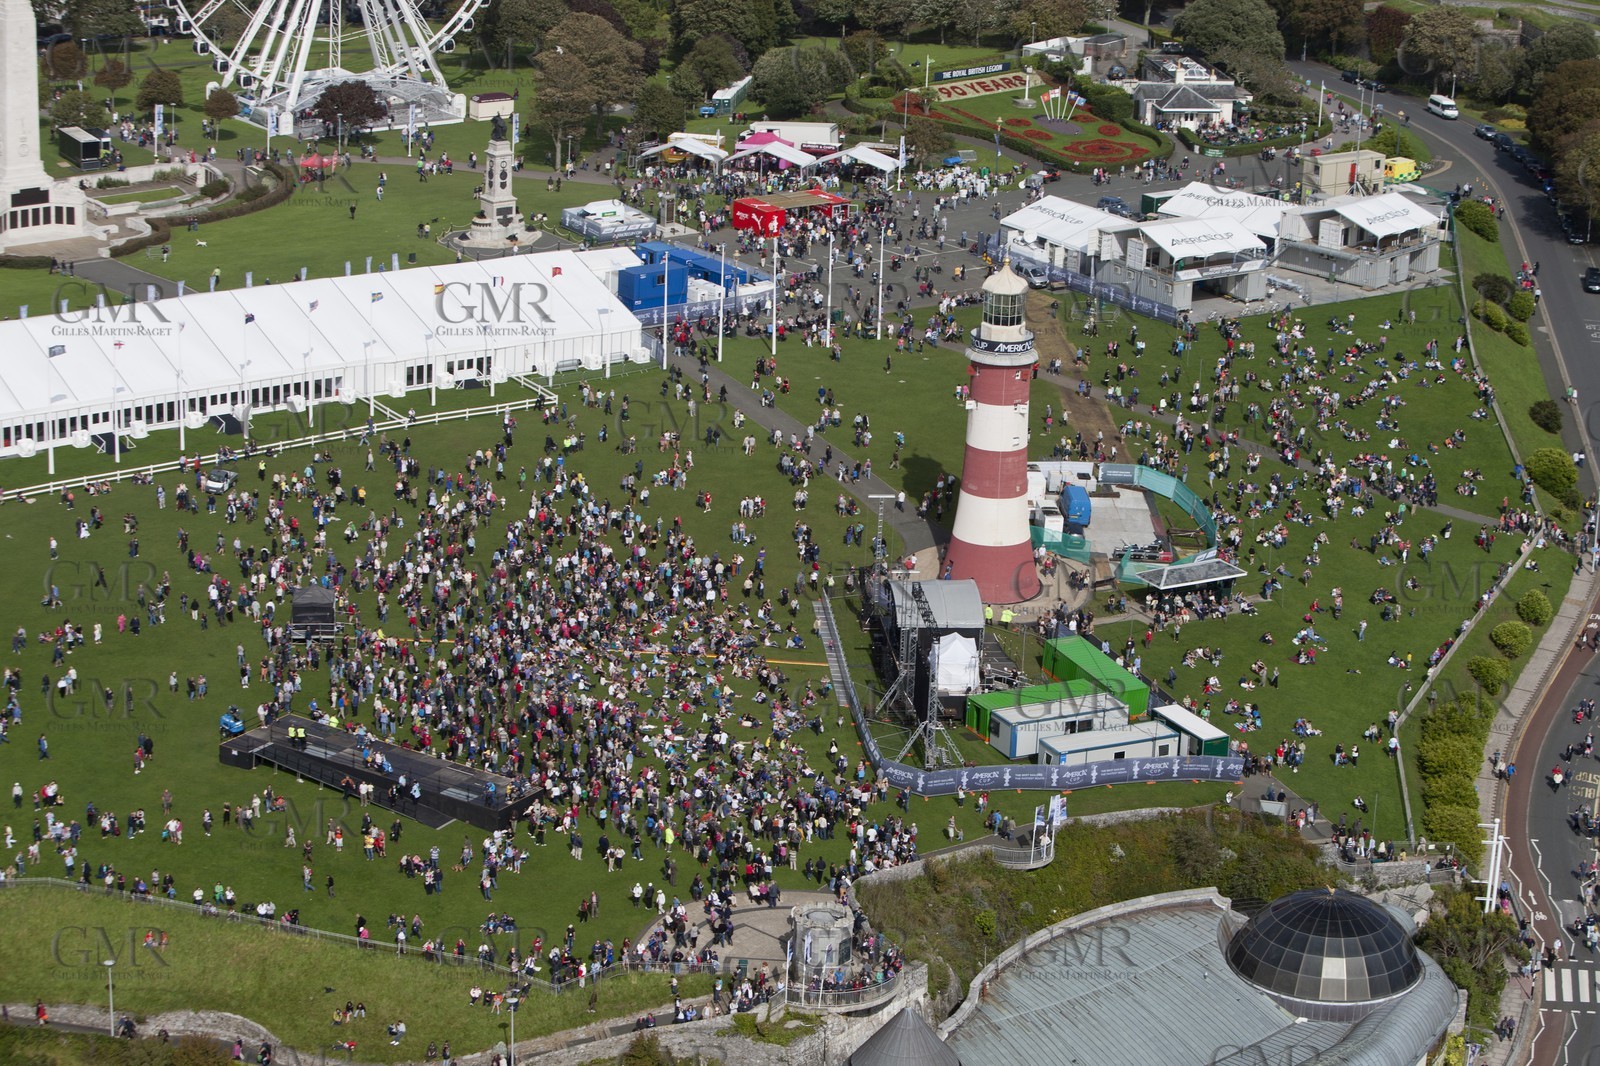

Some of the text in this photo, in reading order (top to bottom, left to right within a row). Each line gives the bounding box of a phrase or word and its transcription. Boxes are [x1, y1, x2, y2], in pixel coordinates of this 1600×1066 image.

[986, 64, 1003, 73] LEGION
[938, 76, 1026, 98] 90 YEARS
[974, 340, 988, 350] CUP
[1576, 772, 1600, 784] STOP
[1573, 786, 1596, 799] BUS
